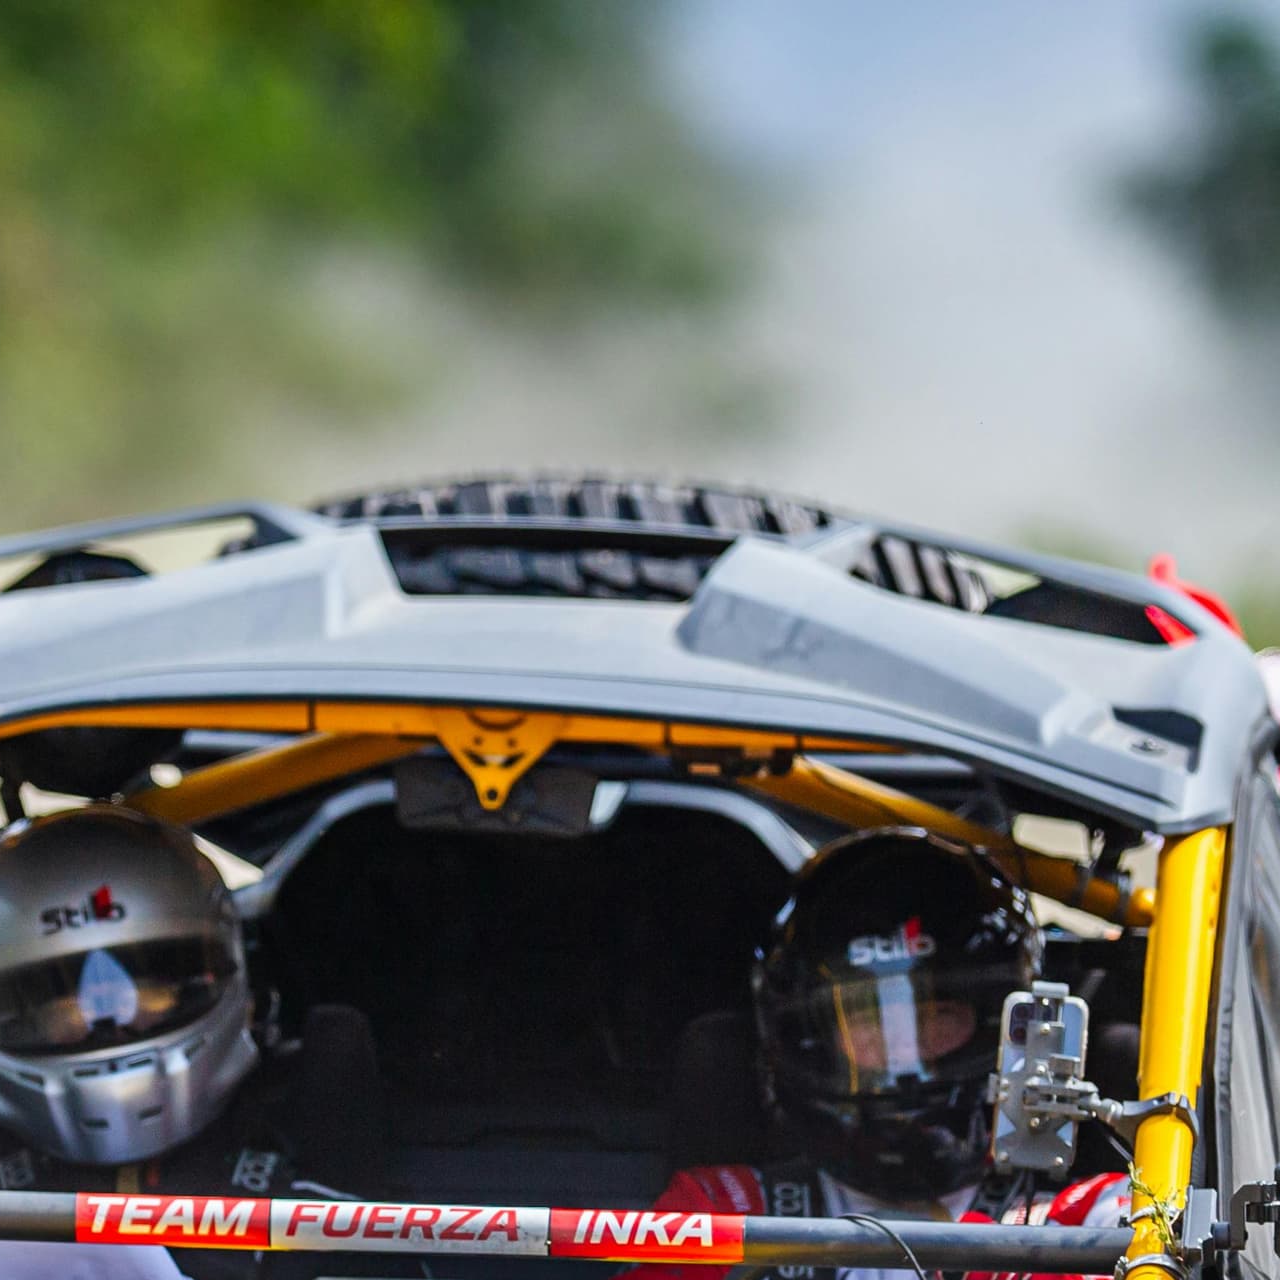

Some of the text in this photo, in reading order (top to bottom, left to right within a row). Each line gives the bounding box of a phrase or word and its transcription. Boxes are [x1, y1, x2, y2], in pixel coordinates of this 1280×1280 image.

[848, 917, 936, 966] Stilo
[87, 1196, 713, 1247] TEAM FUERZA INKA
